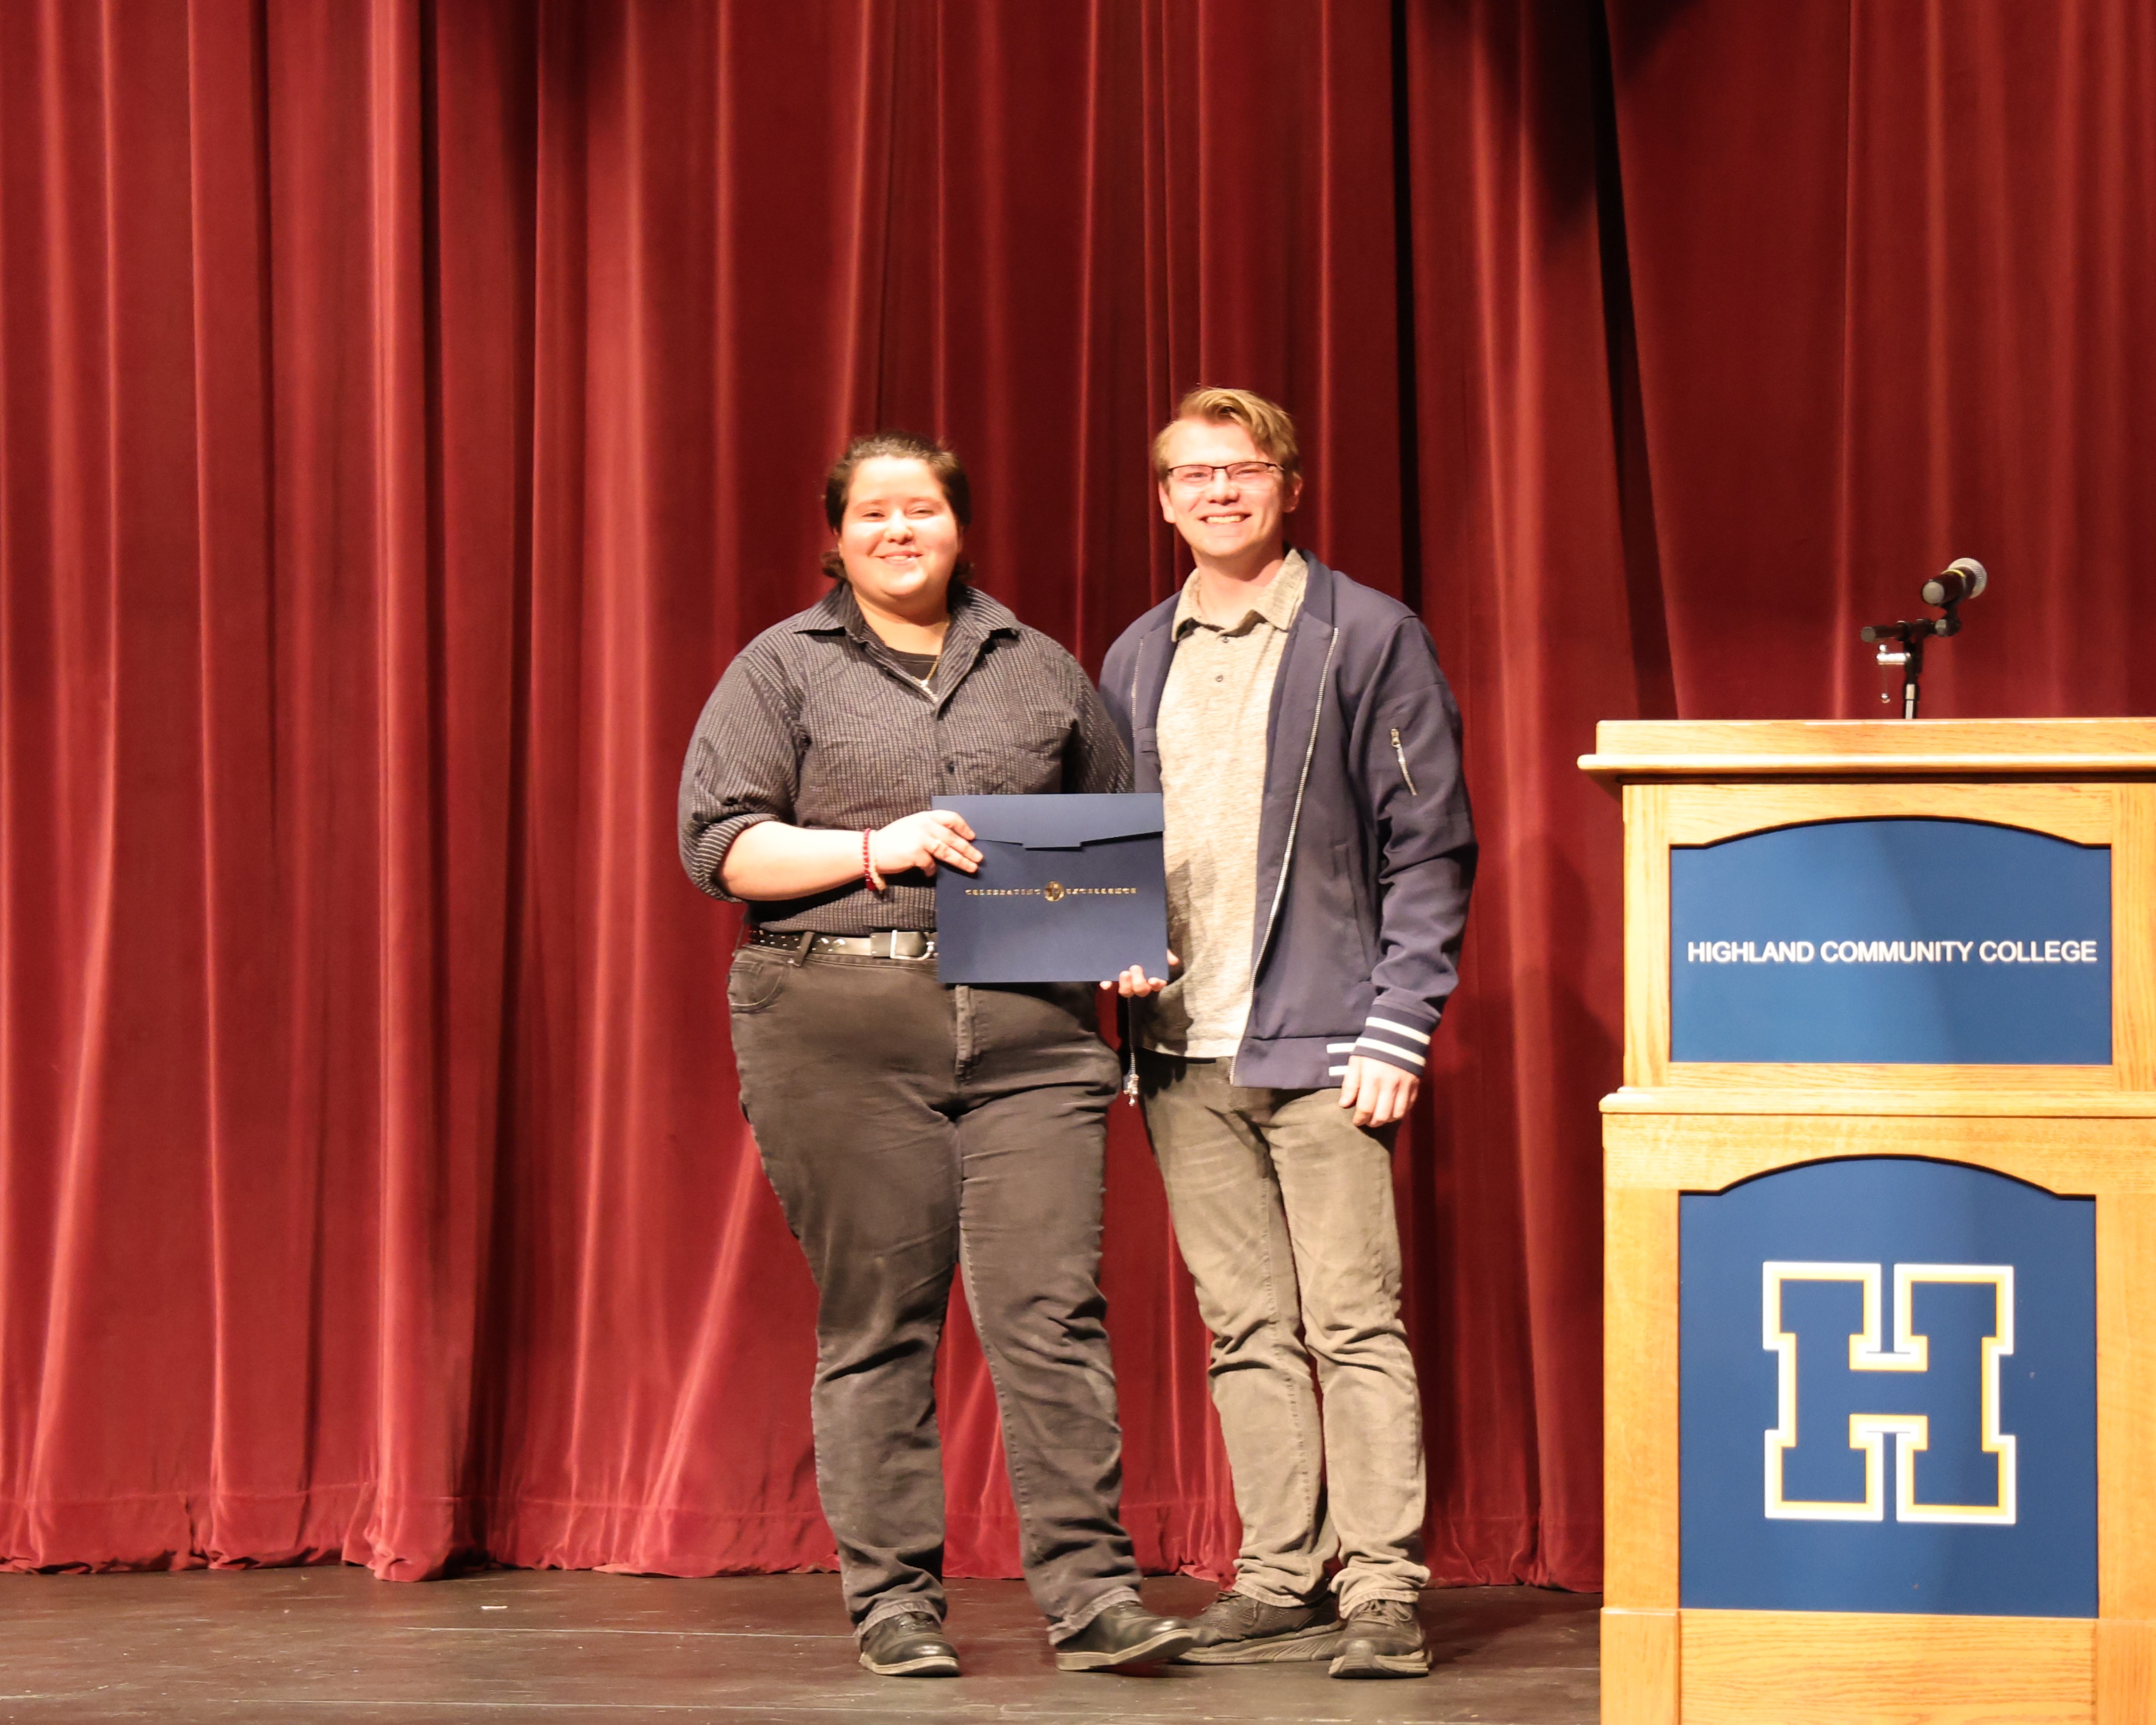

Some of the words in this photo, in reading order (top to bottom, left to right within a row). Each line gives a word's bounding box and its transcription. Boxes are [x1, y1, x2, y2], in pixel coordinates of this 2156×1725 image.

[1686, 940, 1815, 963] HIGHLAND
[1819, 940, 1974, 963] COMMUNITY
[1979, 940, 2097, 963] COLLEGE
[1762, 1261, 2017, 1525] H
